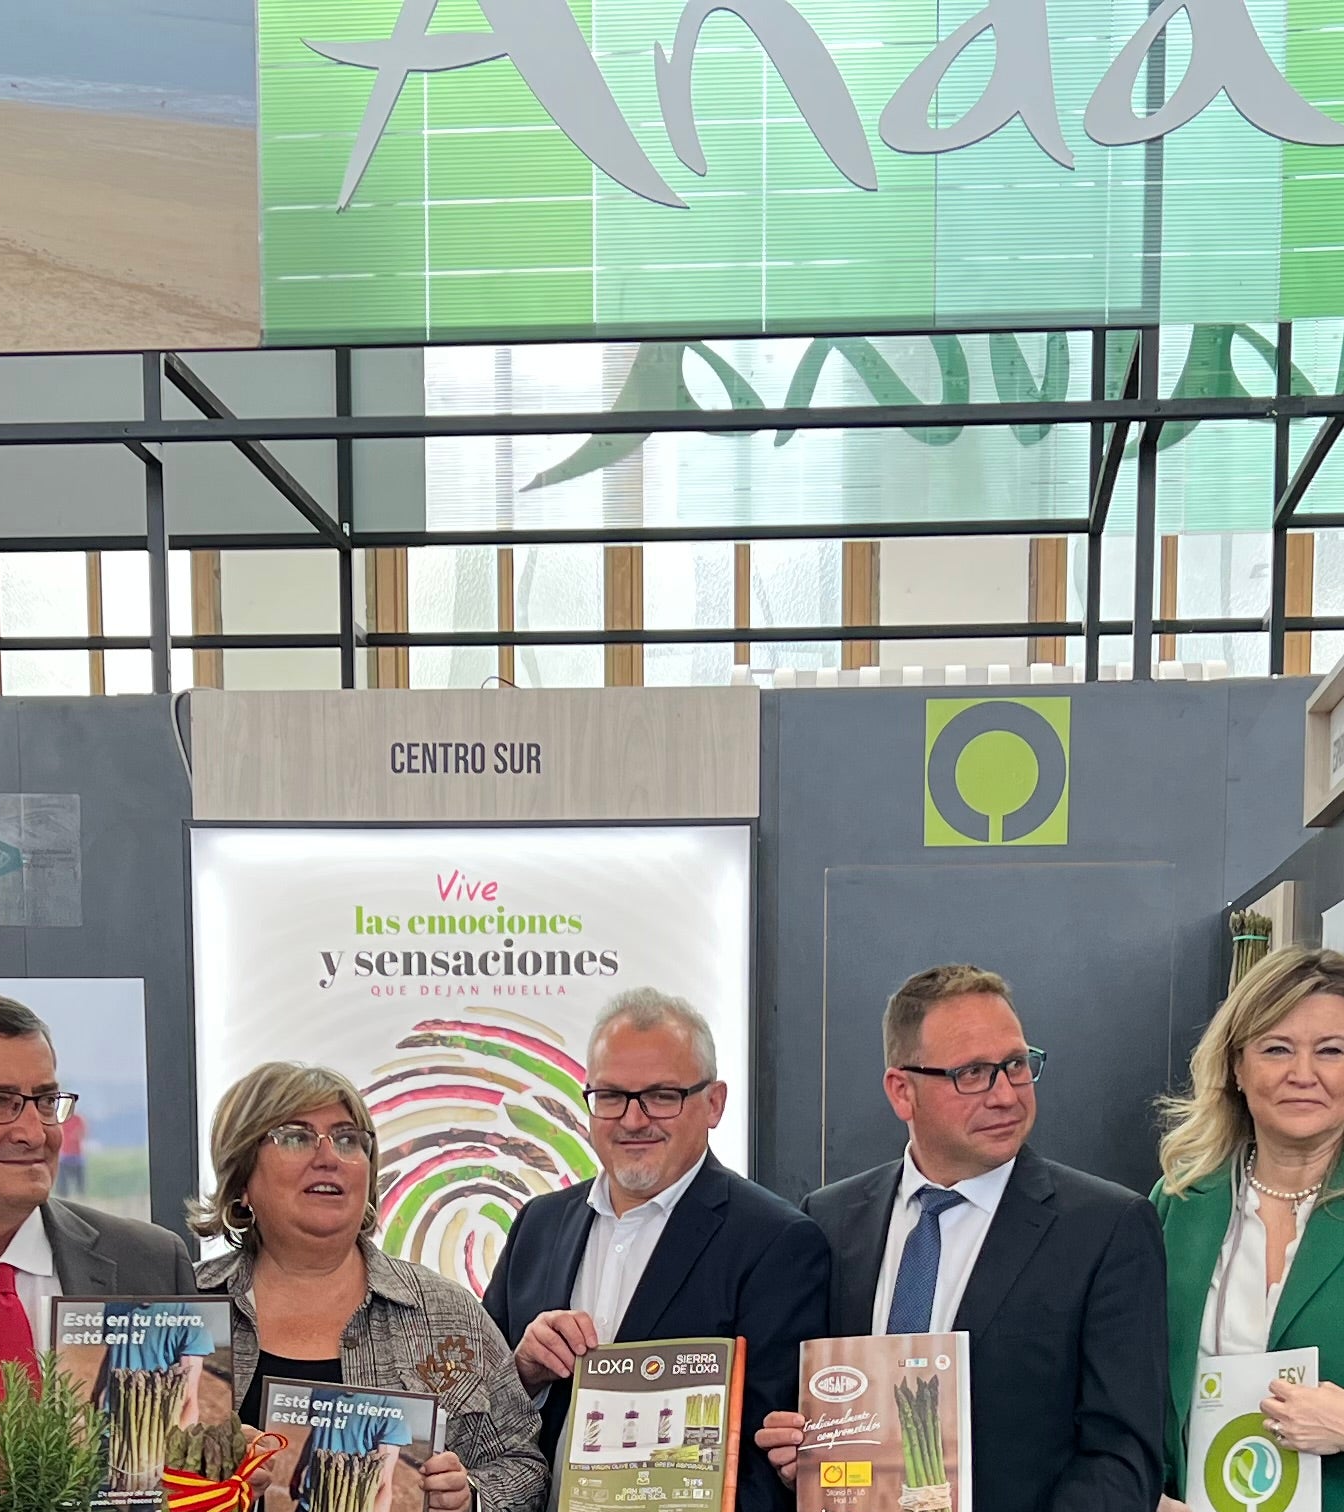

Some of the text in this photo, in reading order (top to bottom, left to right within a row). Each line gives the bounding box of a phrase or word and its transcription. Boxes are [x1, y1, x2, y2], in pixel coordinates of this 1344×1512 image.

[390, 742, 542, 775] CENTRO SUR
[437, 869, 498, 902] Vive
[354, 905, 583, 935] las emociones
[318, 938, 619, 989] y sensaciones
[370, 984, 567, 997] QUE DEJAN HUELLA
[63, 1311, 205, 1328] Está en tu tierra,
[62, 1329, 146, 1345] está en ti
[588, 1358, 634, 1375] LOXA
[676, 1353, 717, 1364] SIERRA
[672, 1363, 719, 1375] DE LOXA
[273, 1393, 405, 1420] Está en tu tierra,
[271, 1410, 348, 1430] está en ti
